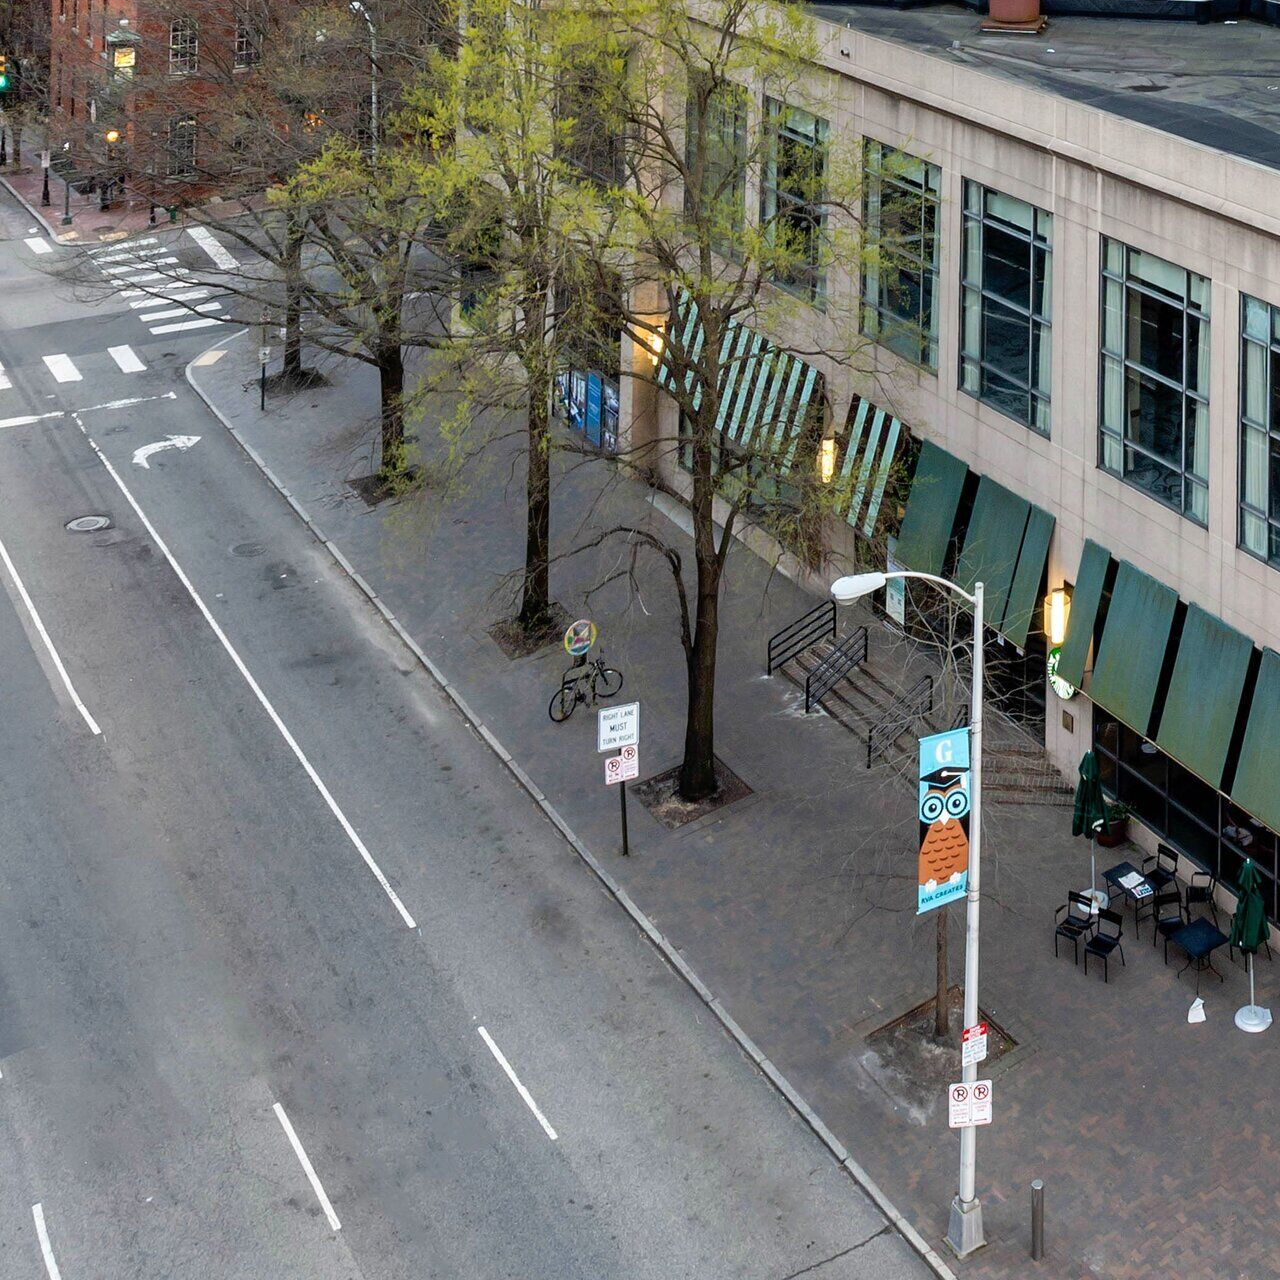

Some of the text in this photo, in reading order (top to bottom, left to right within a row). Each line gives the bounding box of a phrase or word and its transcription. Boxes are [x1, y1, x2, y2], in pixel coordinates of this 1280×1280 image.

[602, 709, 634, 721] RIGHT LANE
[609, 722, 627, 732] MUST
[602, 733, 635, 745] TURN RIGHT
[935, 739, 953, 764] G
[921, 884, 963, 904] RVA CREATES
